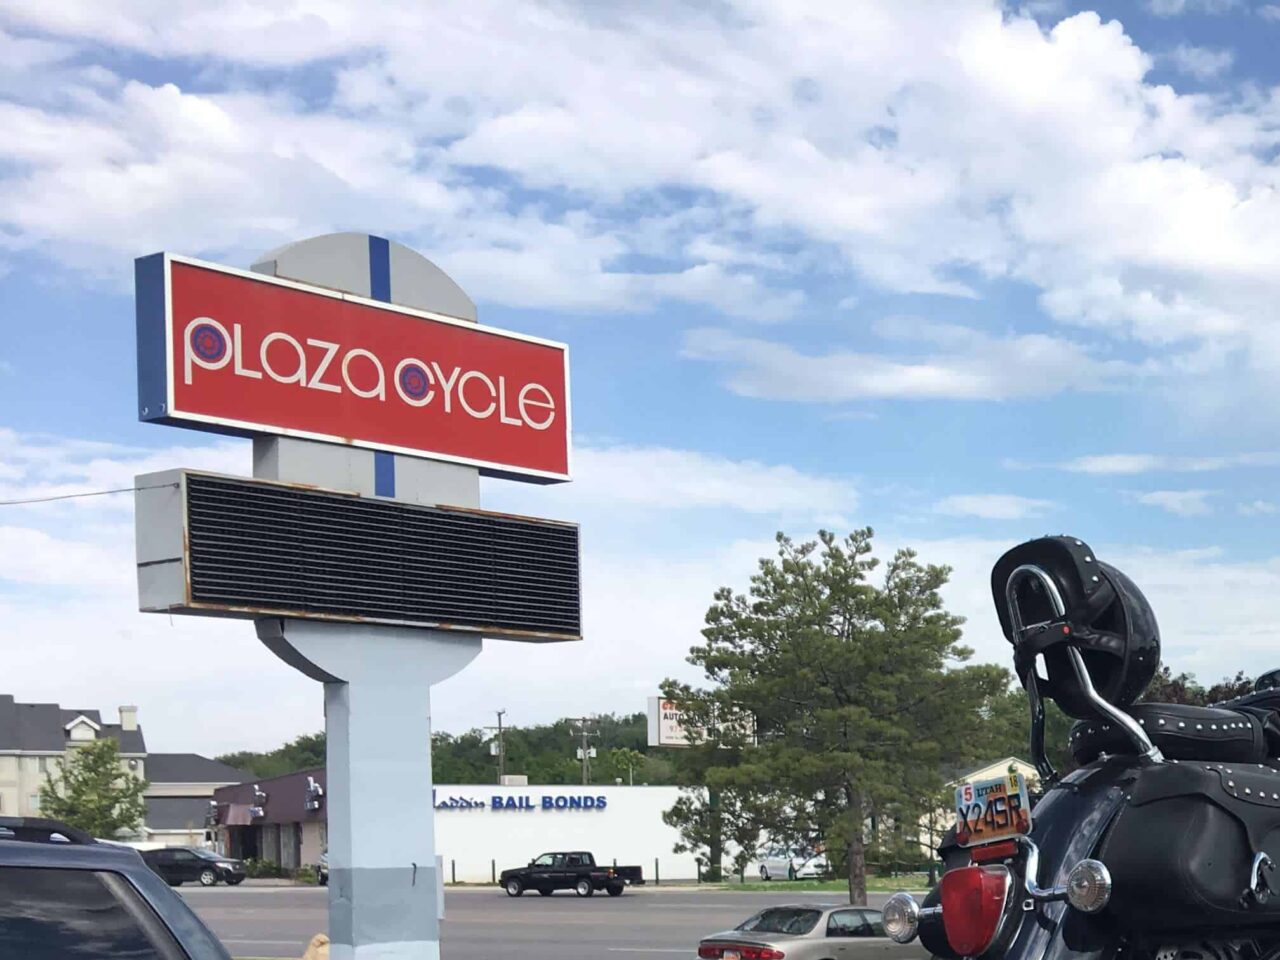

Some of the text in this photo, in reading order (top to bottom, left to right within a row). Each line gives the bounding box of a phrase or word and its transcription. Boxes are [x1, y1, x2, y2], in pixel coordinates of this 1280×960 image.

[964, 783, 1002, 802] 5 UTAH
[491, 795, 536, 810] BAIL
[541, 795, 608, 810] BONDS
